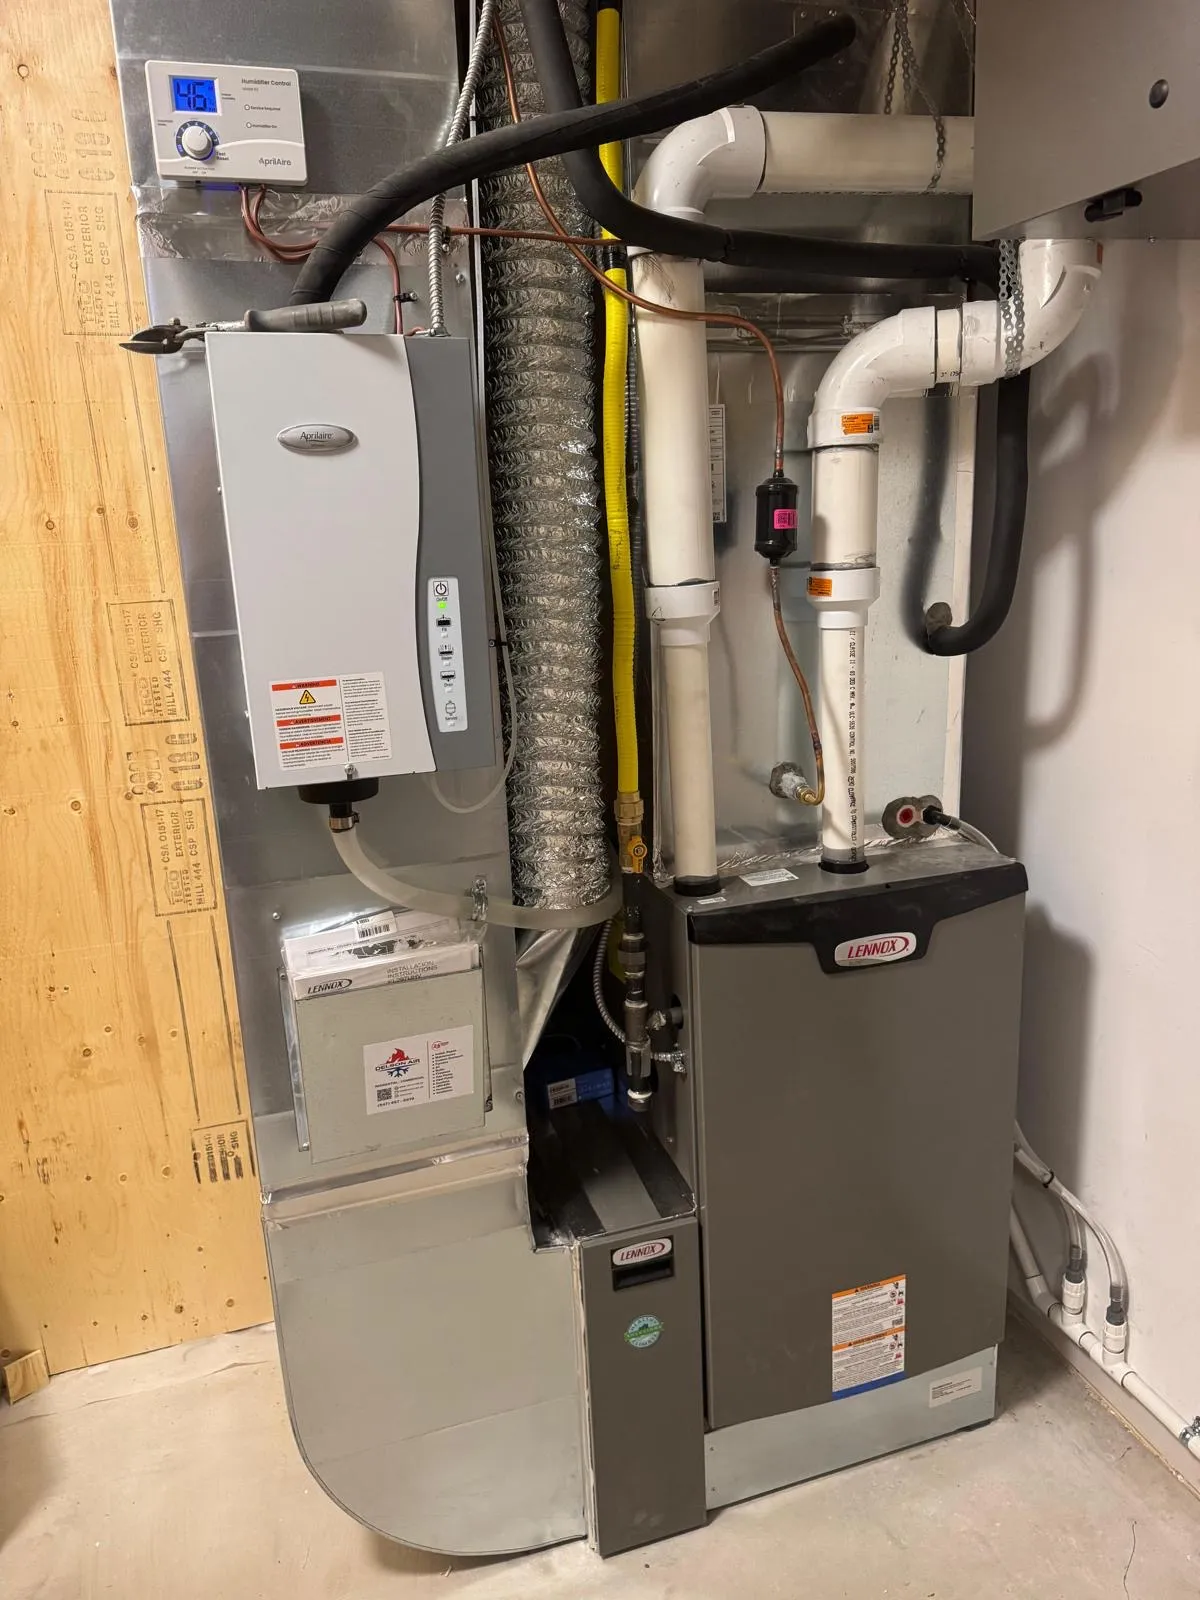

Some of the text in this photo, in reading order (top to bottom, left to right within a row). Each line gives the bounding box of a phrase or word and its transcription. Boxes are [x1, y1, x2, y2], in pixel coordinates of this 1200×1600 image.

[258, 157, 292, 167] AprilAire
[78, 205, 94, 264] EXTERIOR
[300, 431, 333, 442] Aprilaire
[170, 811, 184, 857] EXTERIOR
[161, 843, 170, 863] CSA
[185, 810, 206, 905] MILL 444 CSP SHG
[847, 939, 898, 959] LENNOX
[307, 980, 344, 994] LENNOX
[620, 1245, 657, 1261] LENNOX
